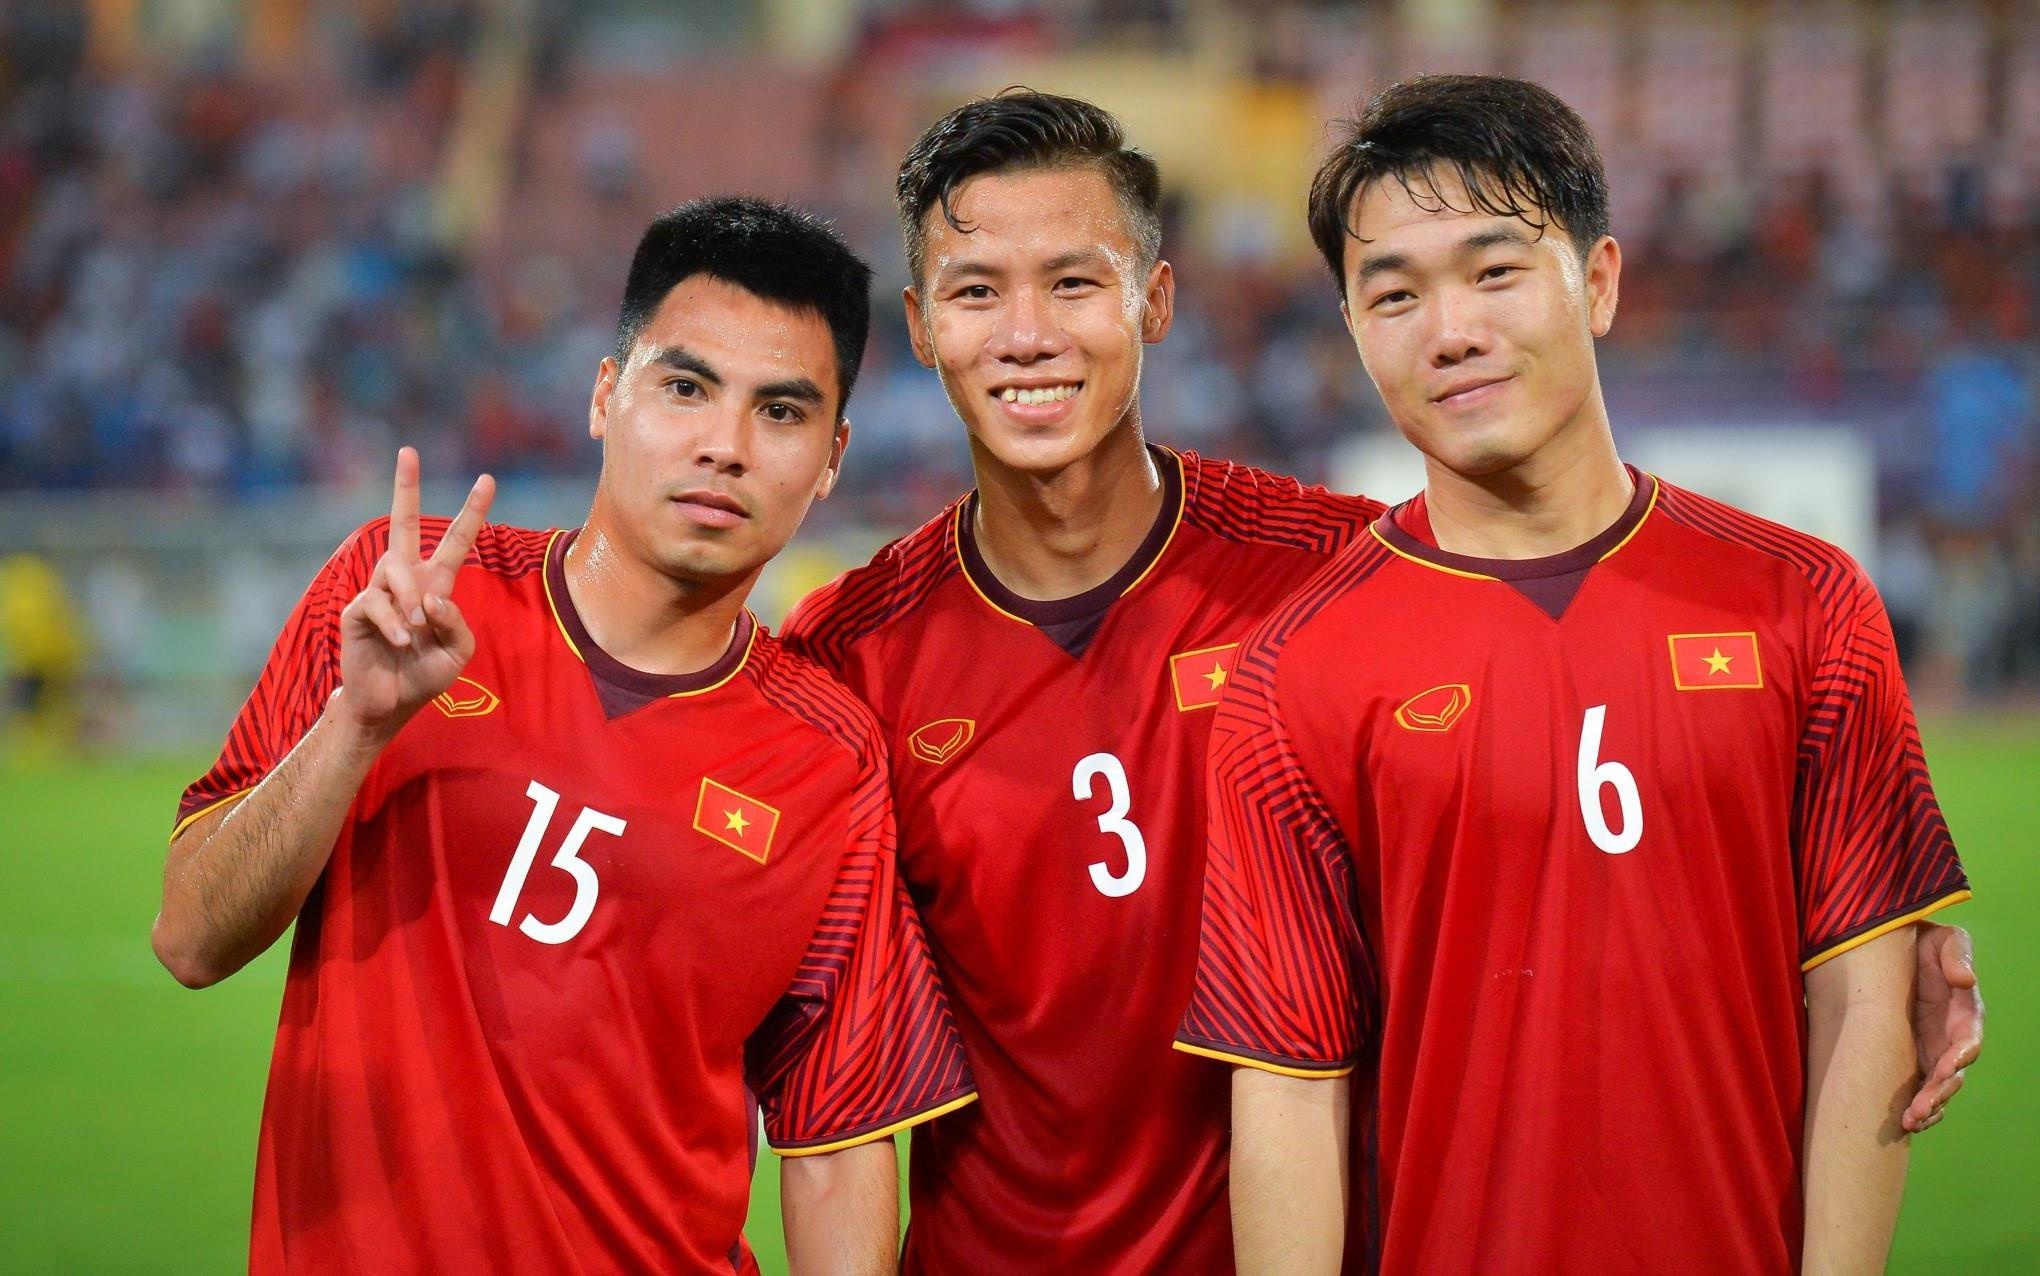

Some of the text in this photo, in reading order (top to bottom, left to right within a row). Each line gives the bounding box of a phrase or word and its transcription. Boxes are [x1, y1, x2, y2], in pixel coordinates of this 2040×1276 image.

[1071, 752, 1148, 898] 3
[1577, 704, 1644, 855] 6
[488, 779, 627, 945] 15
